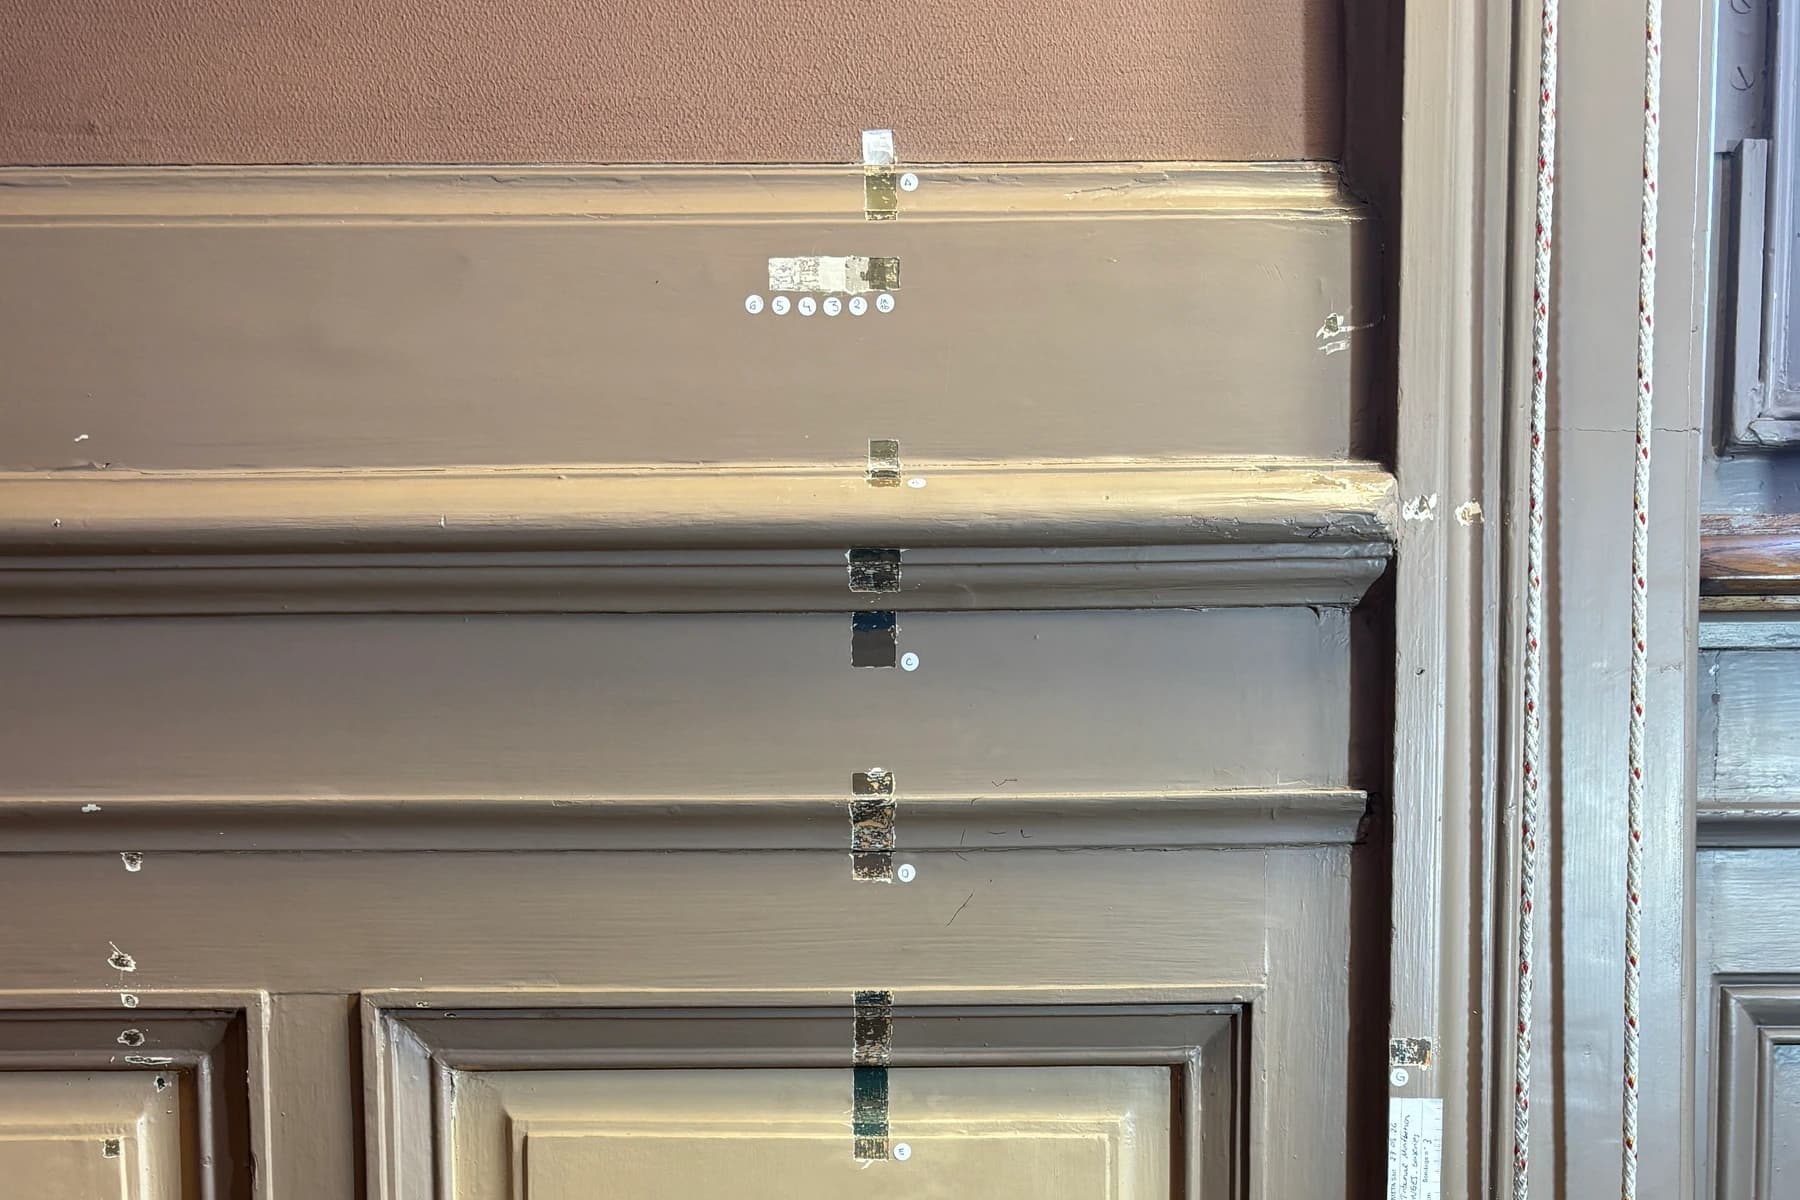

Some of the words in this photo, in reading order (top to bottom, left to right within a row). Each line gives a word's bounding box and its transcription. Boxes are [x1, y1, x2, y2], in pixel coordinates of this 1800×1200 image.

[749, 300, 757, 310] 6
[776, 300, 784, 312] 5
[802, 300, 811, 312] 4
[828, 300, 839, 312] 3
[854, 298, 861, 310] 2
[1395, 1072, 1405, 1082] G
